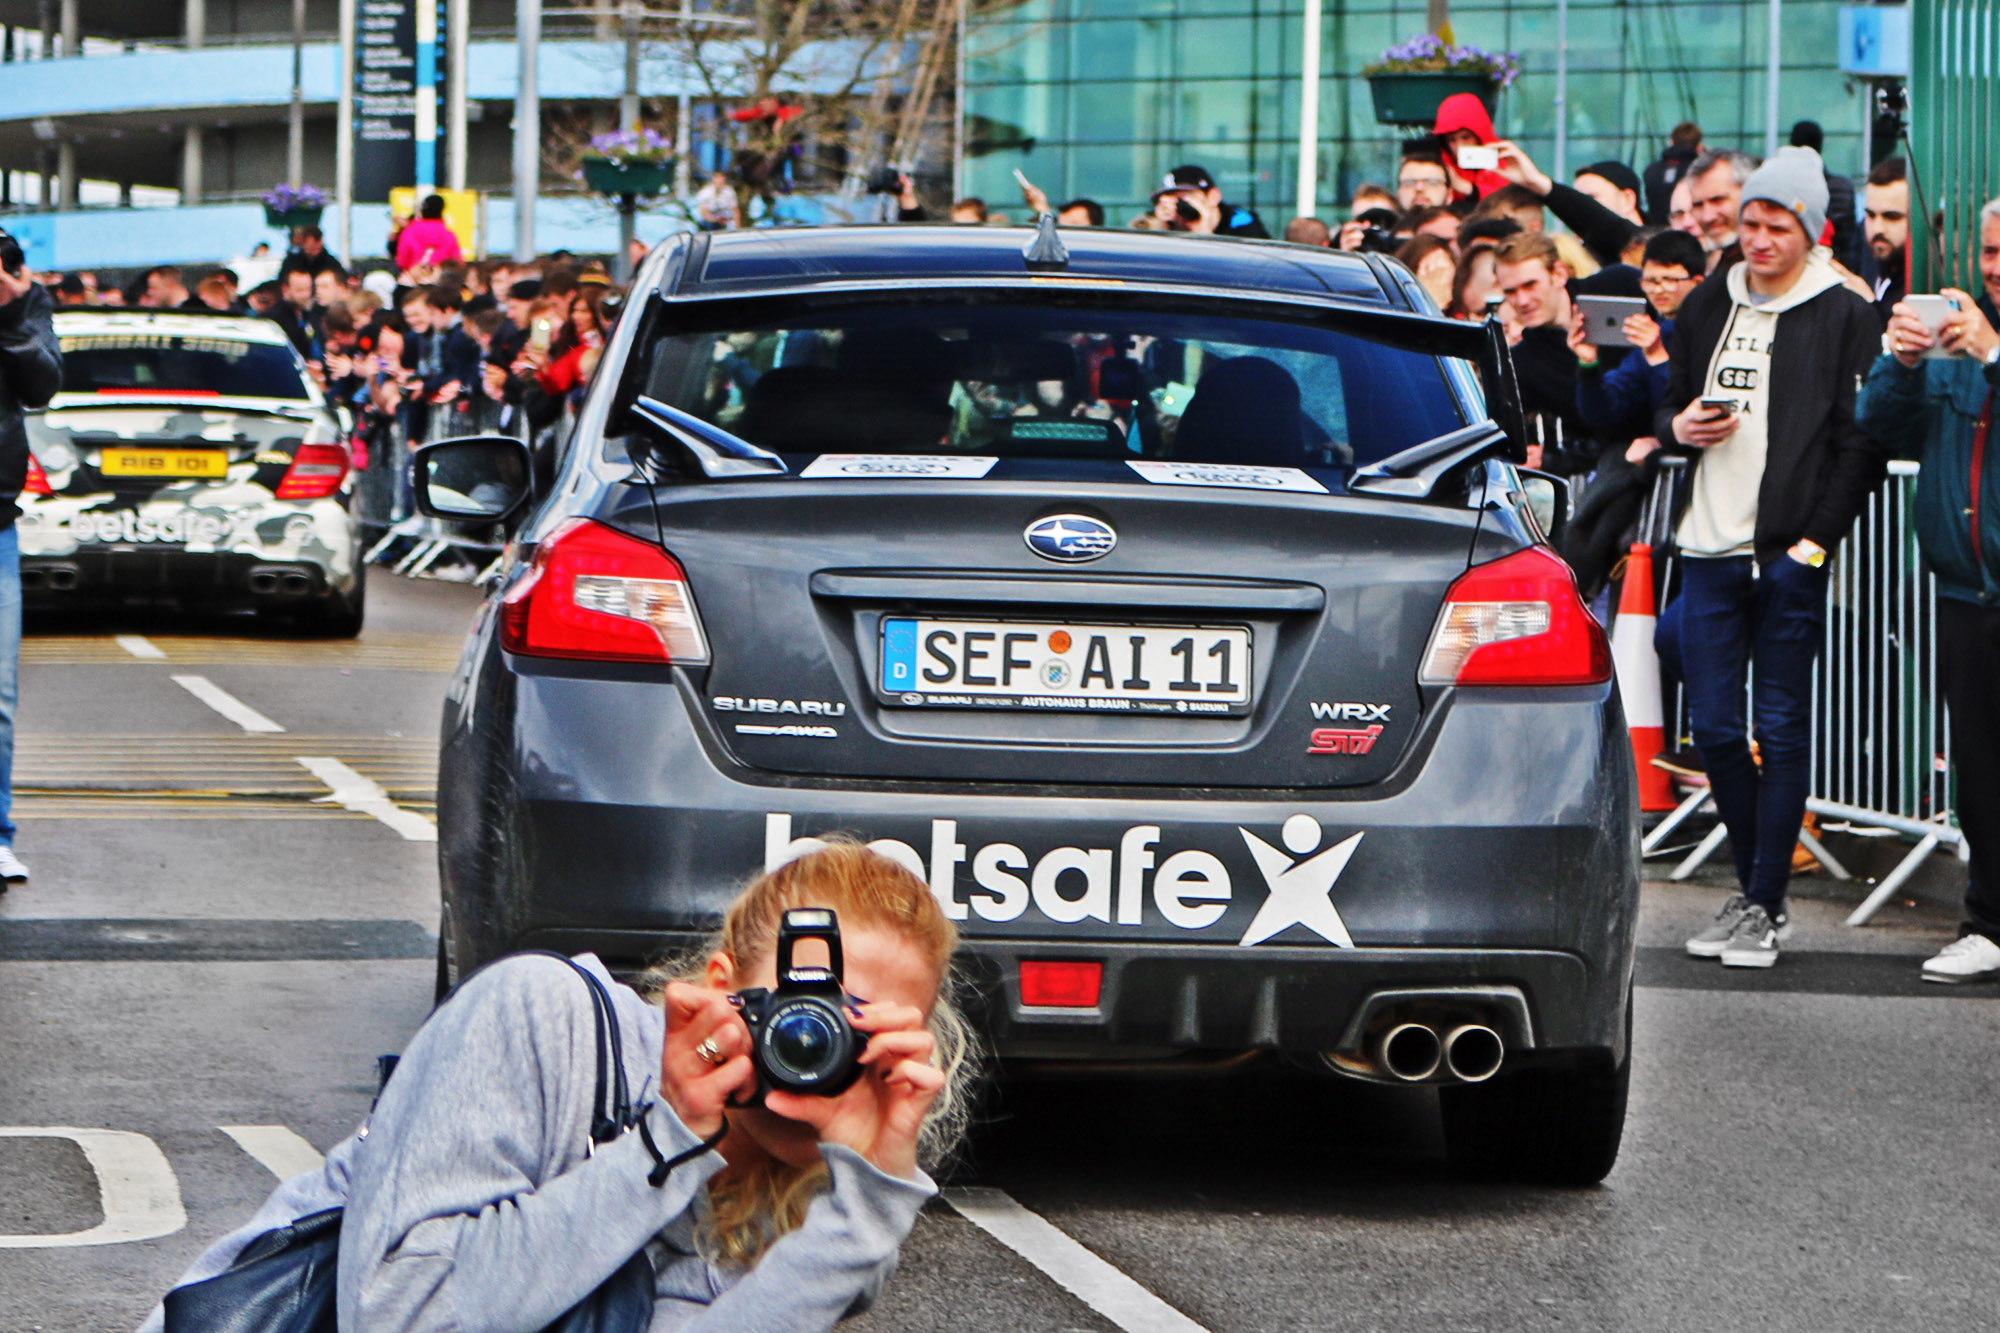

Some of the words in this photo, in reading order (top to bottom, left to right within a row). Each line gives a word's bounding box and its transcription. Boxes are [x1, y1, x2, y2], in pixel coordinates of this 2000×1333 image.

[893, 662, 907, 679] D
[922, 629, 1038, 687] SEF
[1080, 635, 1150, 691] AI
[1168, 637, 1239, 693] 11
[712, 696, 846, 716] SUBARU
[927, 695, 972, 705] SUBARU
[1021, 696, 1087, 709] AUTOHAUS
[1088, 698, 1130, 710] BRAUN
[1189, 702, 1229, 713] SUZUKI
[1310, 702, 1391, 721] WRX
[765, 813, 1232, 929] tsafe
